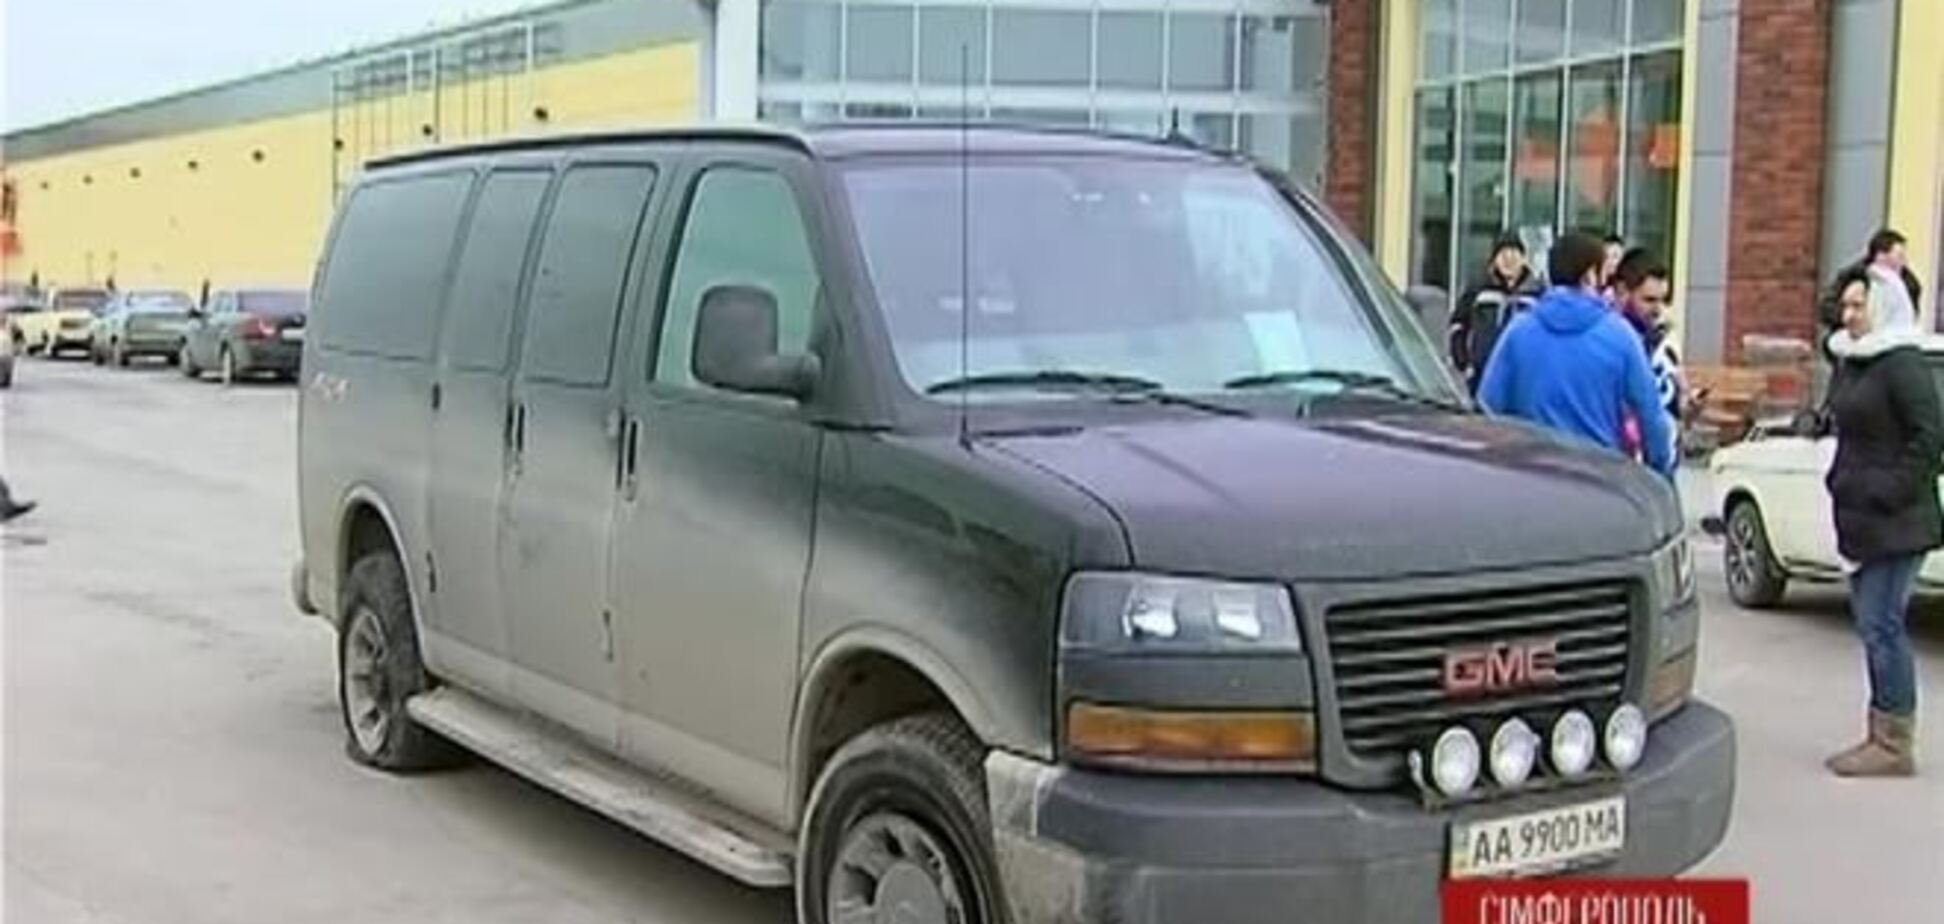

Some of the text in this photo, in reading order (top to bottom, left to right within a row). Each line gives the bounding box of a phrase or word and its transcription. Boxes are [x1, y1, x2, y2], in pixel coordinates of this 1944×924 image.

[1444, 640, 1557, 690] GMC
[1473, 805, 1619, 867] AA 9900 MA
